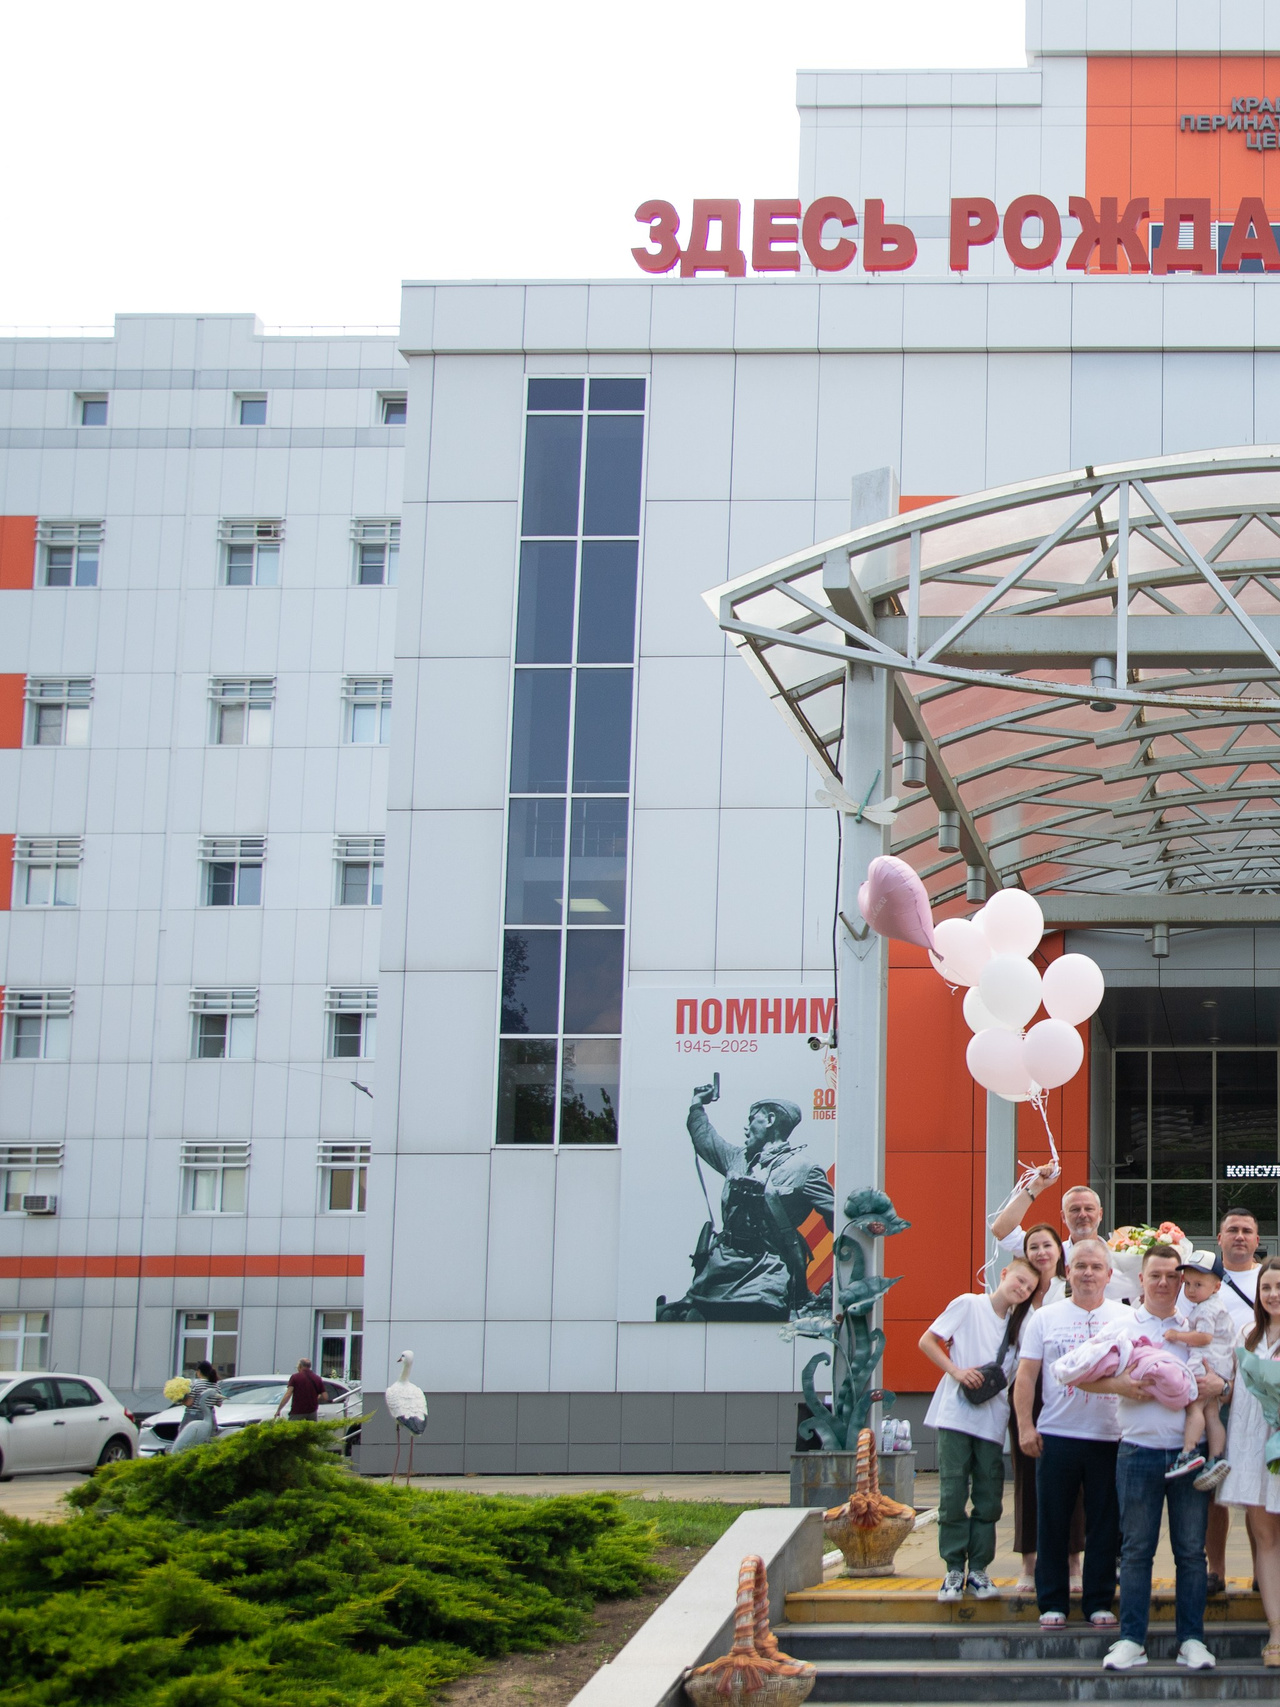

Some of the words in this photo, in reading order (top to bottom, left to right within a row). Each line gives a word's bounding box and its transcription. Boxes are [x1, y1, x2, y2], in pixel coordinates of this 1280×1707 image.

[631, 196, 917, 277] ЗДЕСЬ
[676, 998, 838, 1035] ПОМНИМ
[813, 1088, 835, 1107] 80
